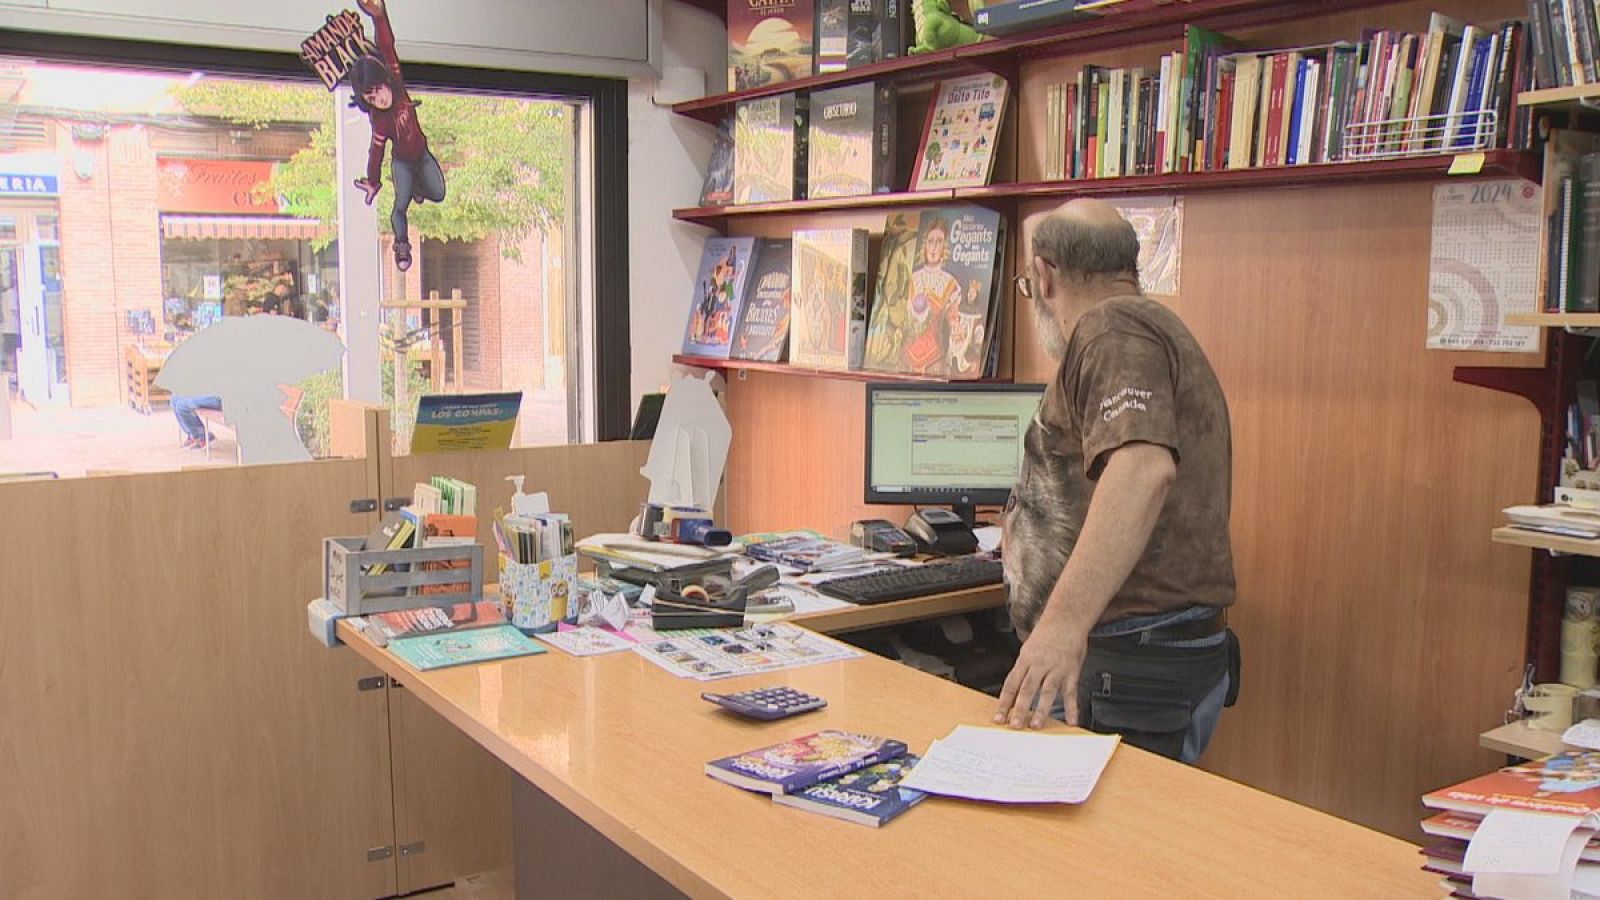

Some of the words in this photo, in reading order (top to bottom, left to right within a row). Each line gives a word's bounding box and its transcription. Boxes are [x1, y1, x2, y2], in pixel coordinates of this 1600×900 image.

[302, 10, 360, 63] AMANDA
[314, 28, 380, 90] BLACK
[188, 163, 257, 186] Fruites
[1470, 182, 1513, 204] 2024
